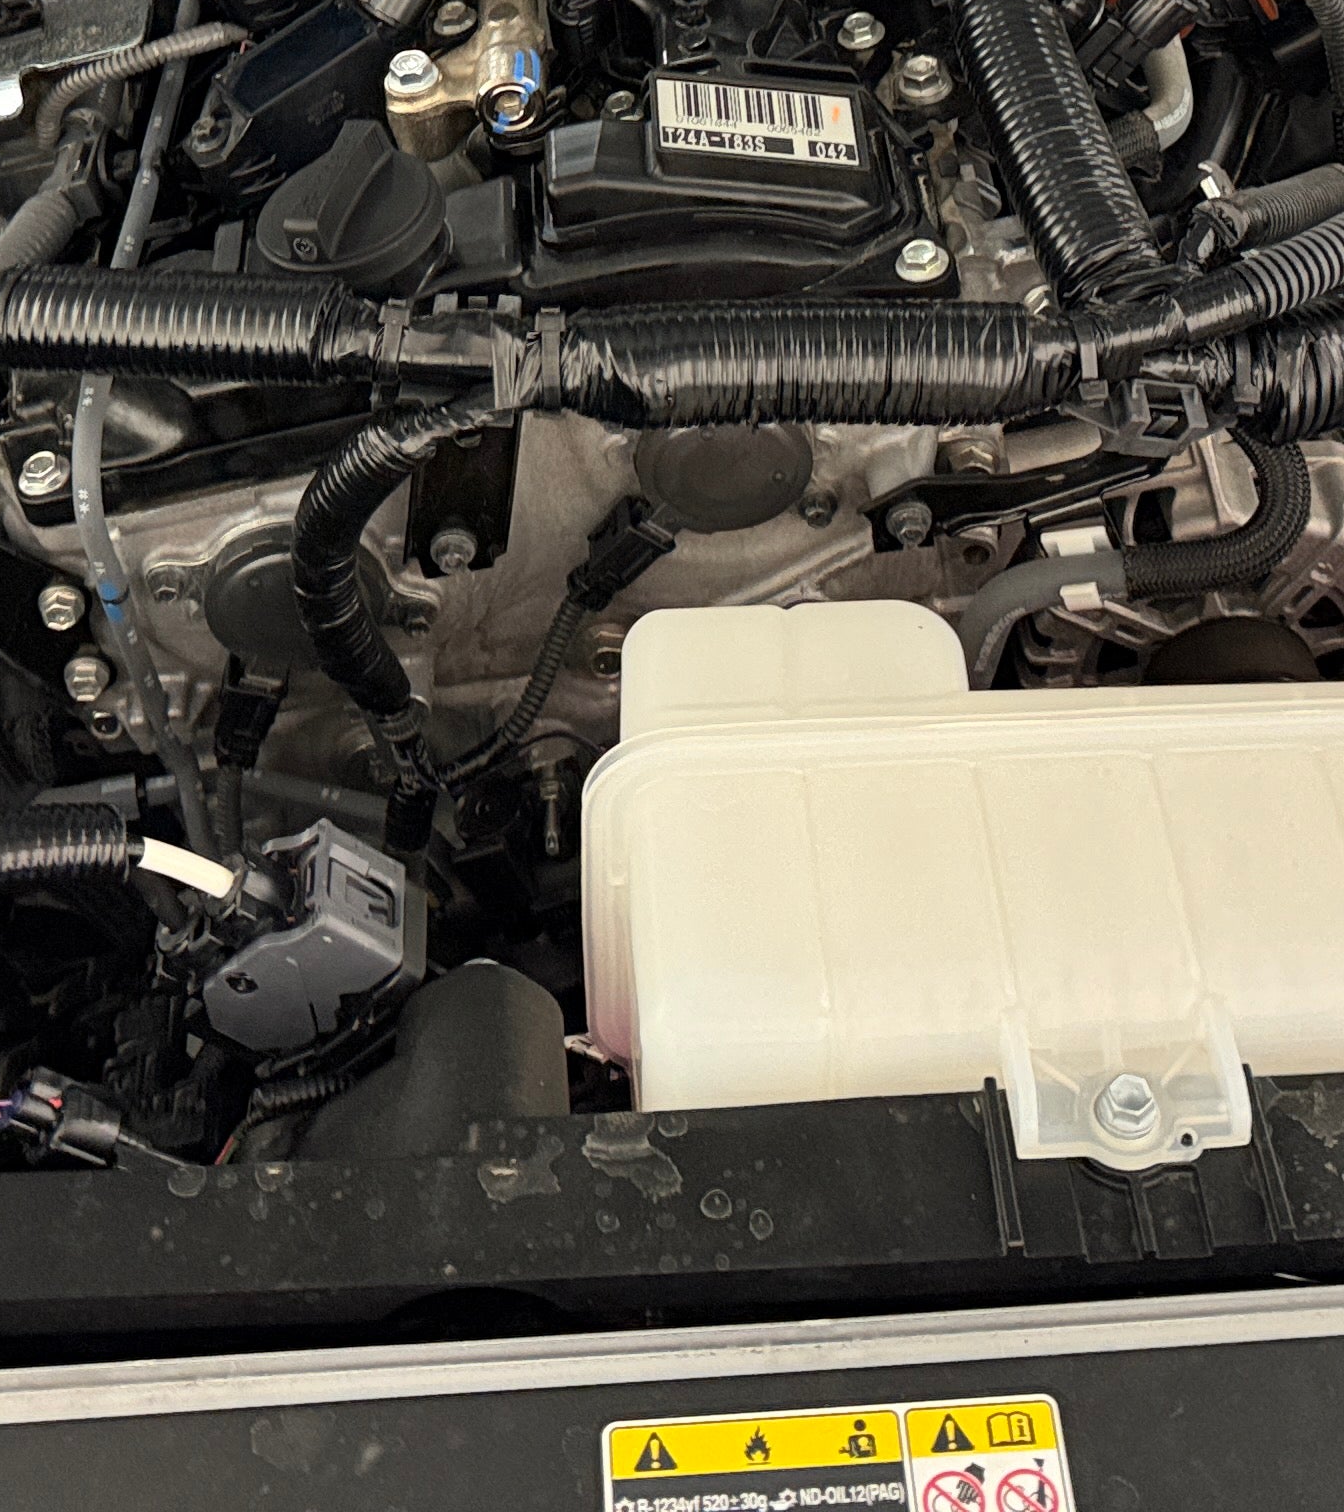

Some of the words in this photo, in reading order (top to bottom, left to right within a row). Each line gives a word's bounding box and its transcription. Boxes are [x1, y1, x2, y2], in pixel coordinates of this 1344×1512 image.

[664, 127, 767, 153] T24A-T83S
[815, 141, 849, 161] 042
[800, 1482, 906, 1506] ND-OIL12(PAG)
